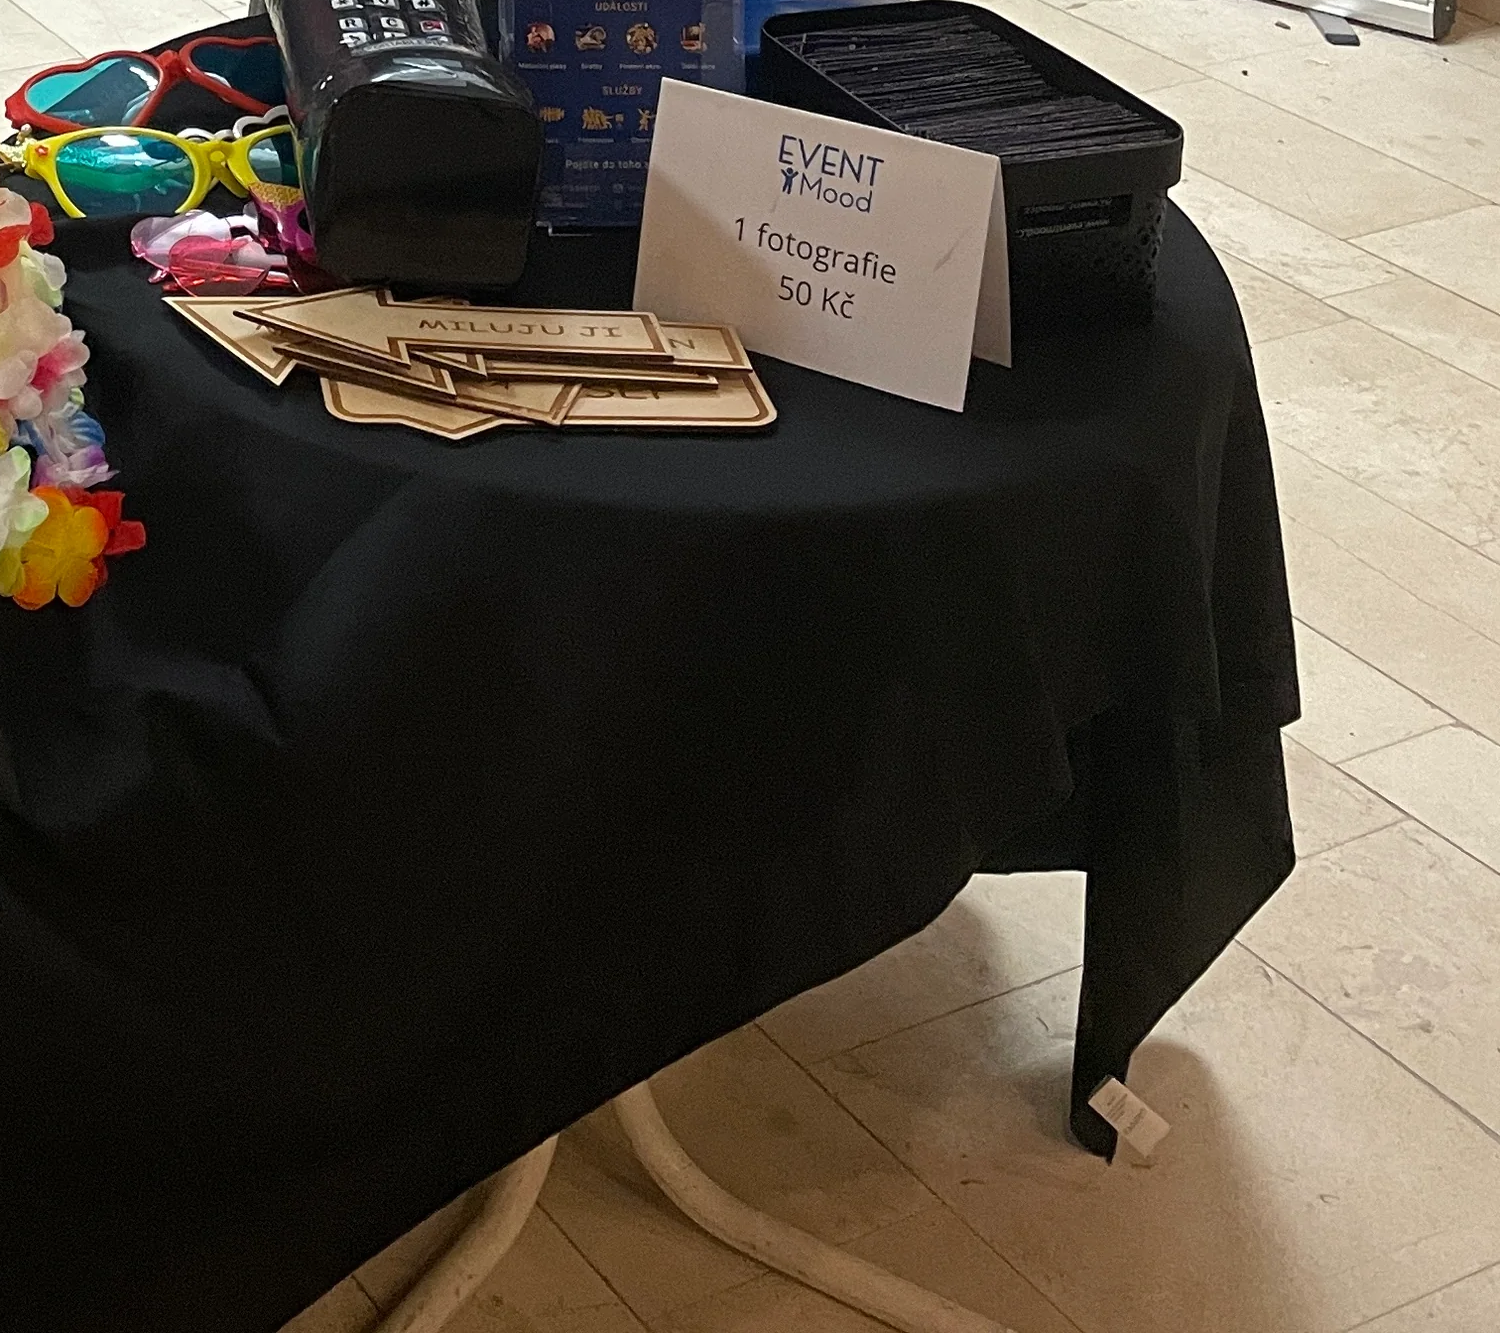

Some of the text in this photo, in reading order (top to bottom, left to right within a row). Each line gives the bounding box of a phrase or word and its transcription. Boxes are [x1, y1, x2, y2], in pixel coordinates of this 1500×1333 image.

[779, 134, 884, 186] EVENT
[800, 173, 873, 213] Mood
[735, 217, 896, 284] 1 fotografie
[778, 275, 855, 319] 50 Kč
[420, 318, 565, 336] MILUJU
